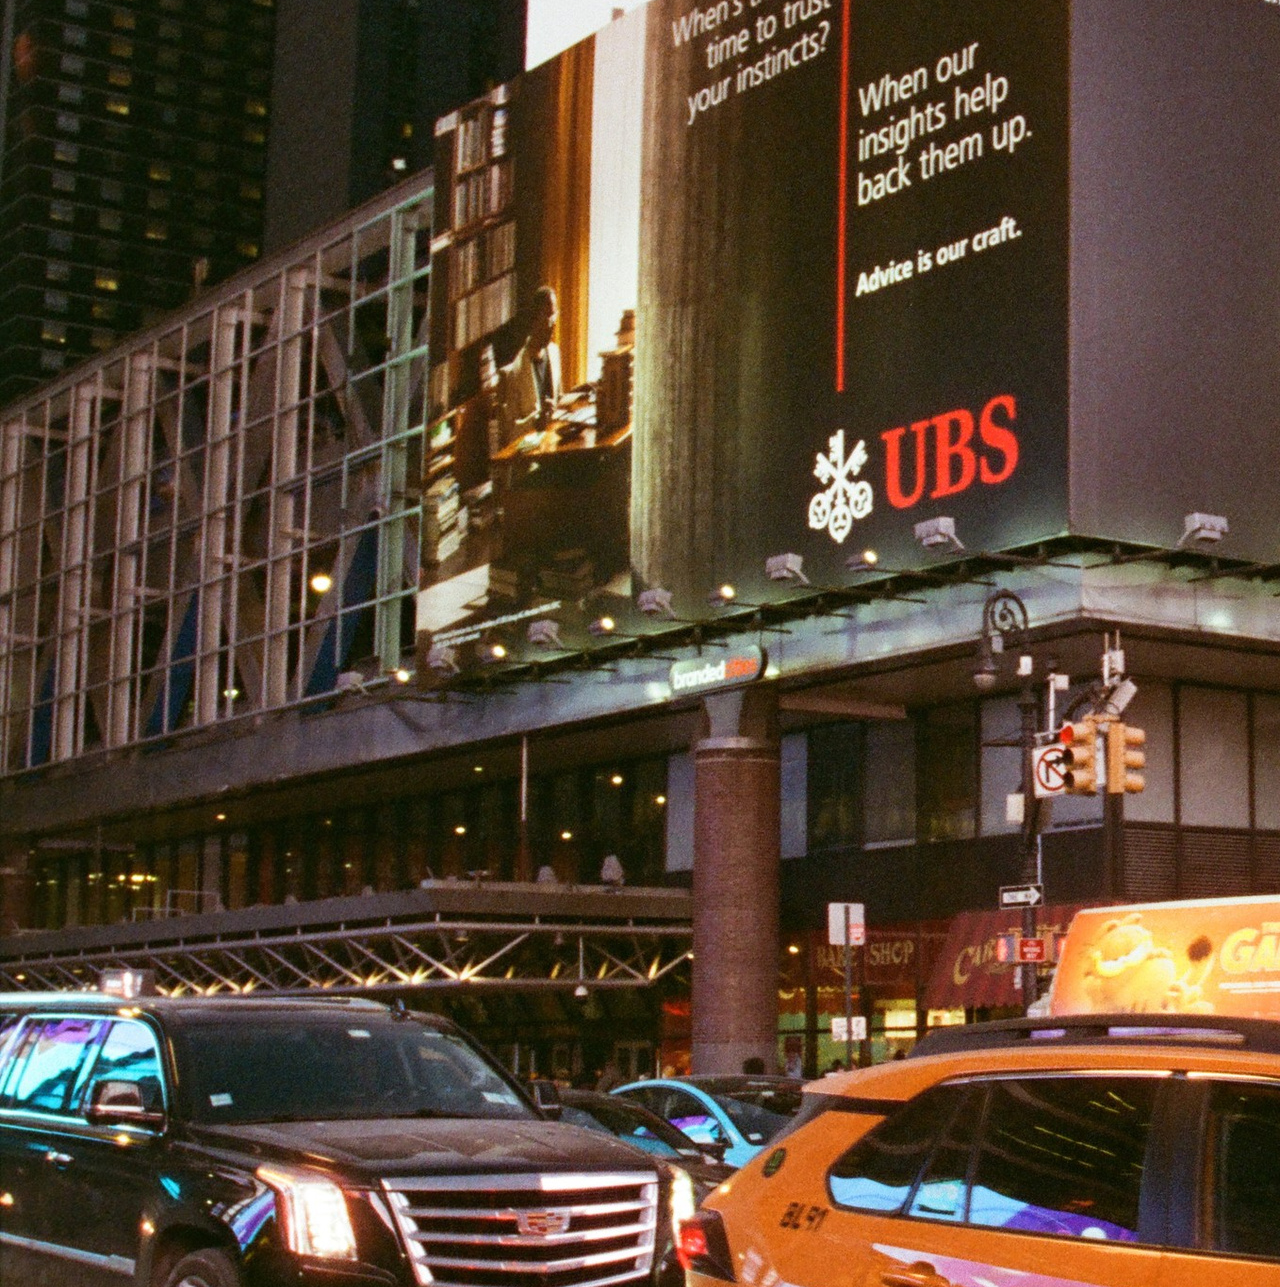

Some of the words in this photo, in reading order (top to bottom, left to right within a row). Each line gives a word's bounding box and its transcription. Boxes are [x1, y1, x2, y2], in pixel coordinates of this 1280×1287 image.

[687, 77, 730, 125] your
[736, 20, 831, 91] instincts?
[706, 33, 748, 69] time
[755, 15, 775, 44] to
[858, 64, 928, 116] When
[936, 41, 979, 82] our
[858, 98, 946, 161] insights
[954, 73, 1008, 121] help
[857, 155, 912, 206] back
[919, 131, 983, 180] them
[992, 114, 1033, 153] up.
[855, 257, 913, 297] Advice
[917, 249, 932, 273] is
[936, 237, 968, 265] our
[972, 216, 1023, 251] craft.
[881, 395, 1020, 509] UBS
[869, 940, 914, 965] SHOP
